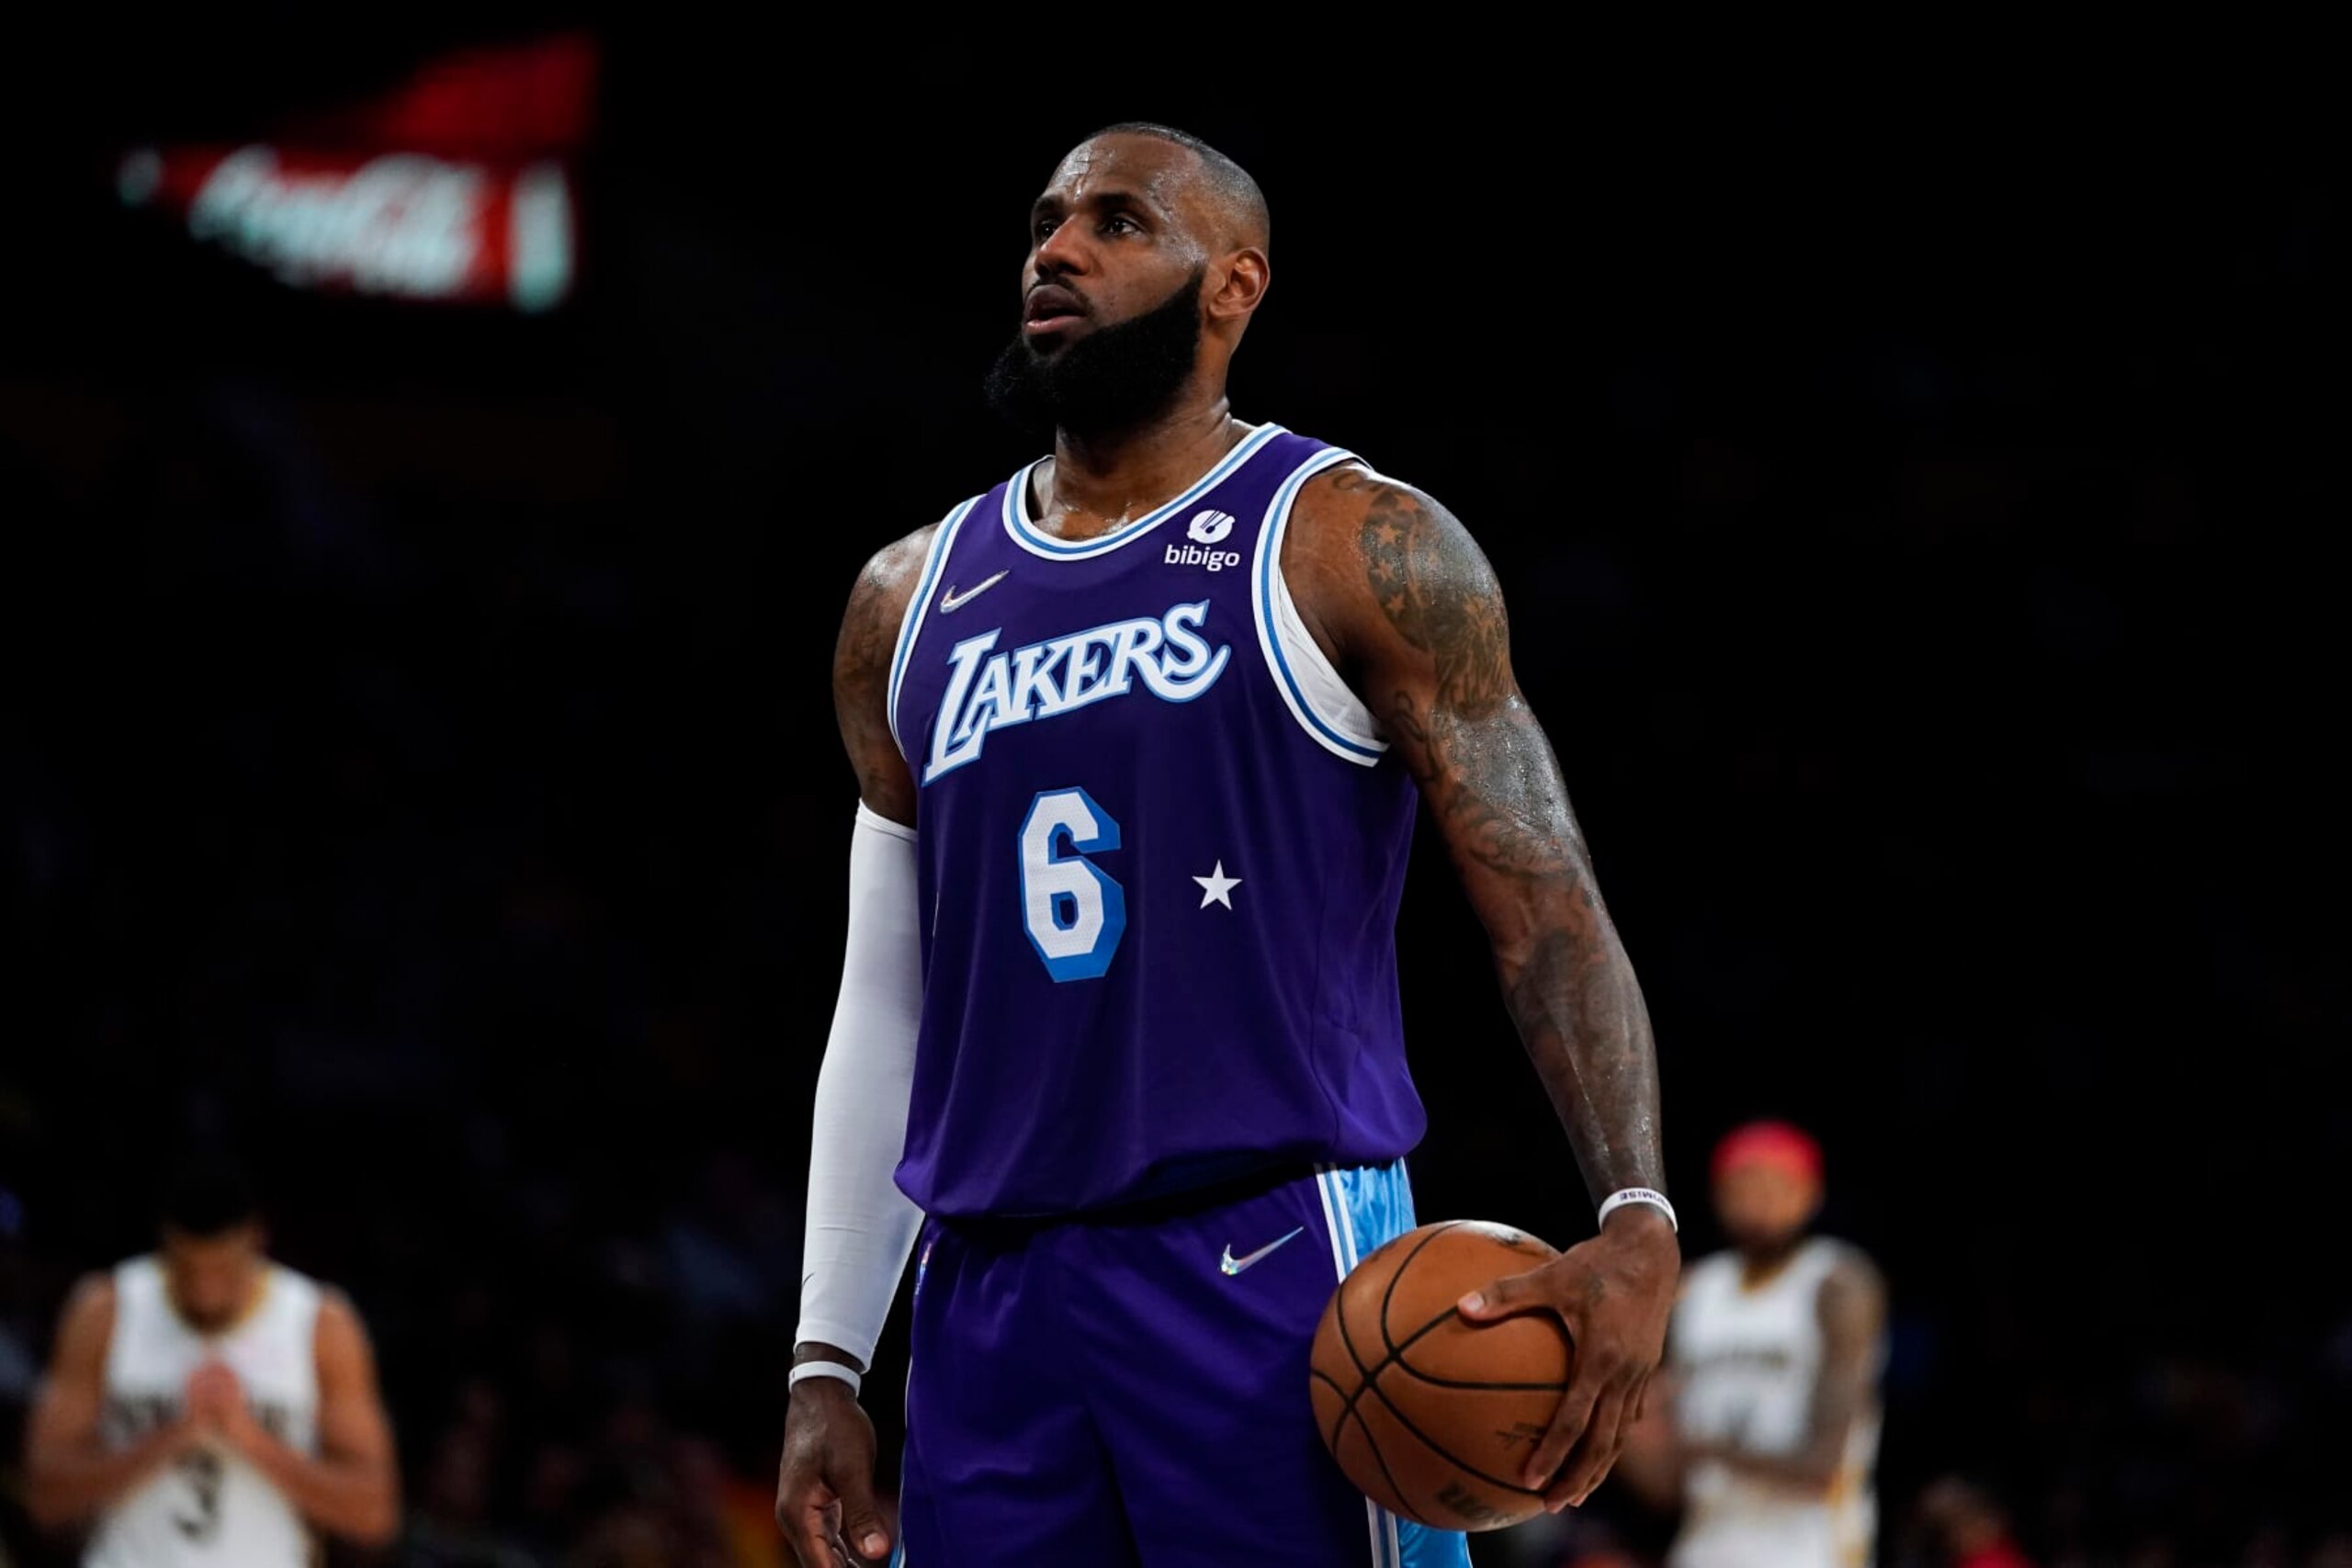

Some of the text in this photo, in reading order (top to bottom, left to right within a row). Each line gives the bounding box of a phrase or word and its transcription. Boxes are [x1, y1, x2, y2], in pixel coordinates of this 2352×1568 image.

[1164, 544, 1240, 571] bibigo
[922, 599, 1231, 787] LAKERS
[1018, 786, 1126, 983] 6
